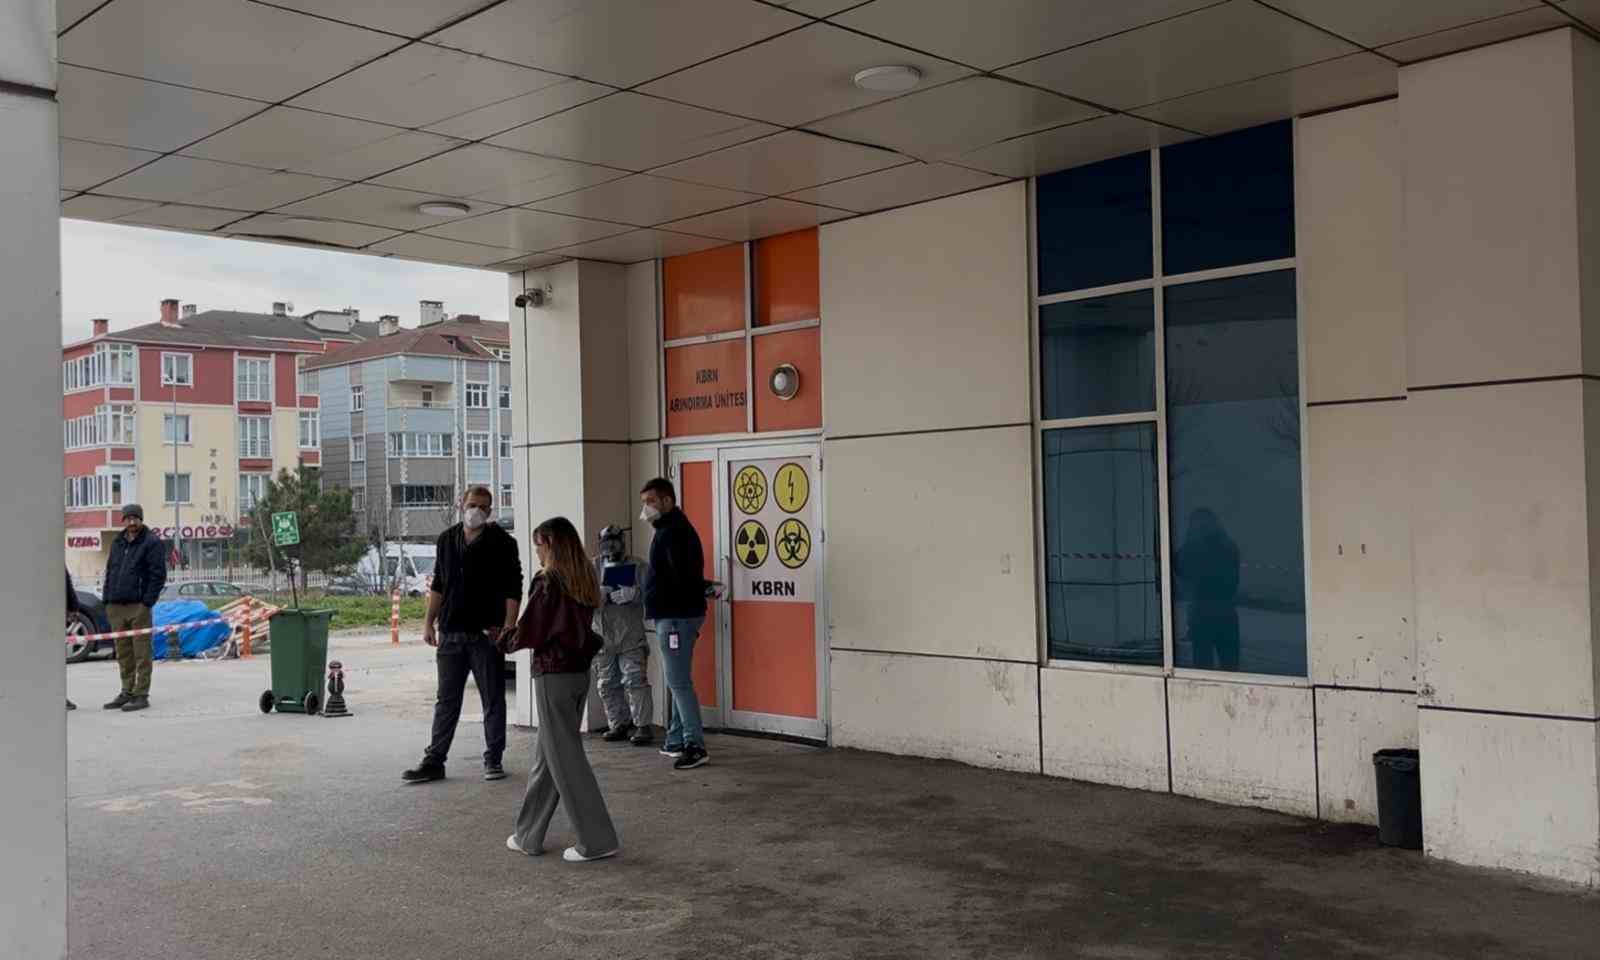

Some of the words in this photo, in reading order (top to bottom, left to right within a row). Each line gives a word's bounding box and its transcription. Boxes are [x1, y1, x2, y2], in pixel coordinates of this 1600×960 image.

[696, 368, 719, 384] KBRN
[670, 394, 713, 412] ARINDIRMA
[751, 580, 795, 597] KBRN
